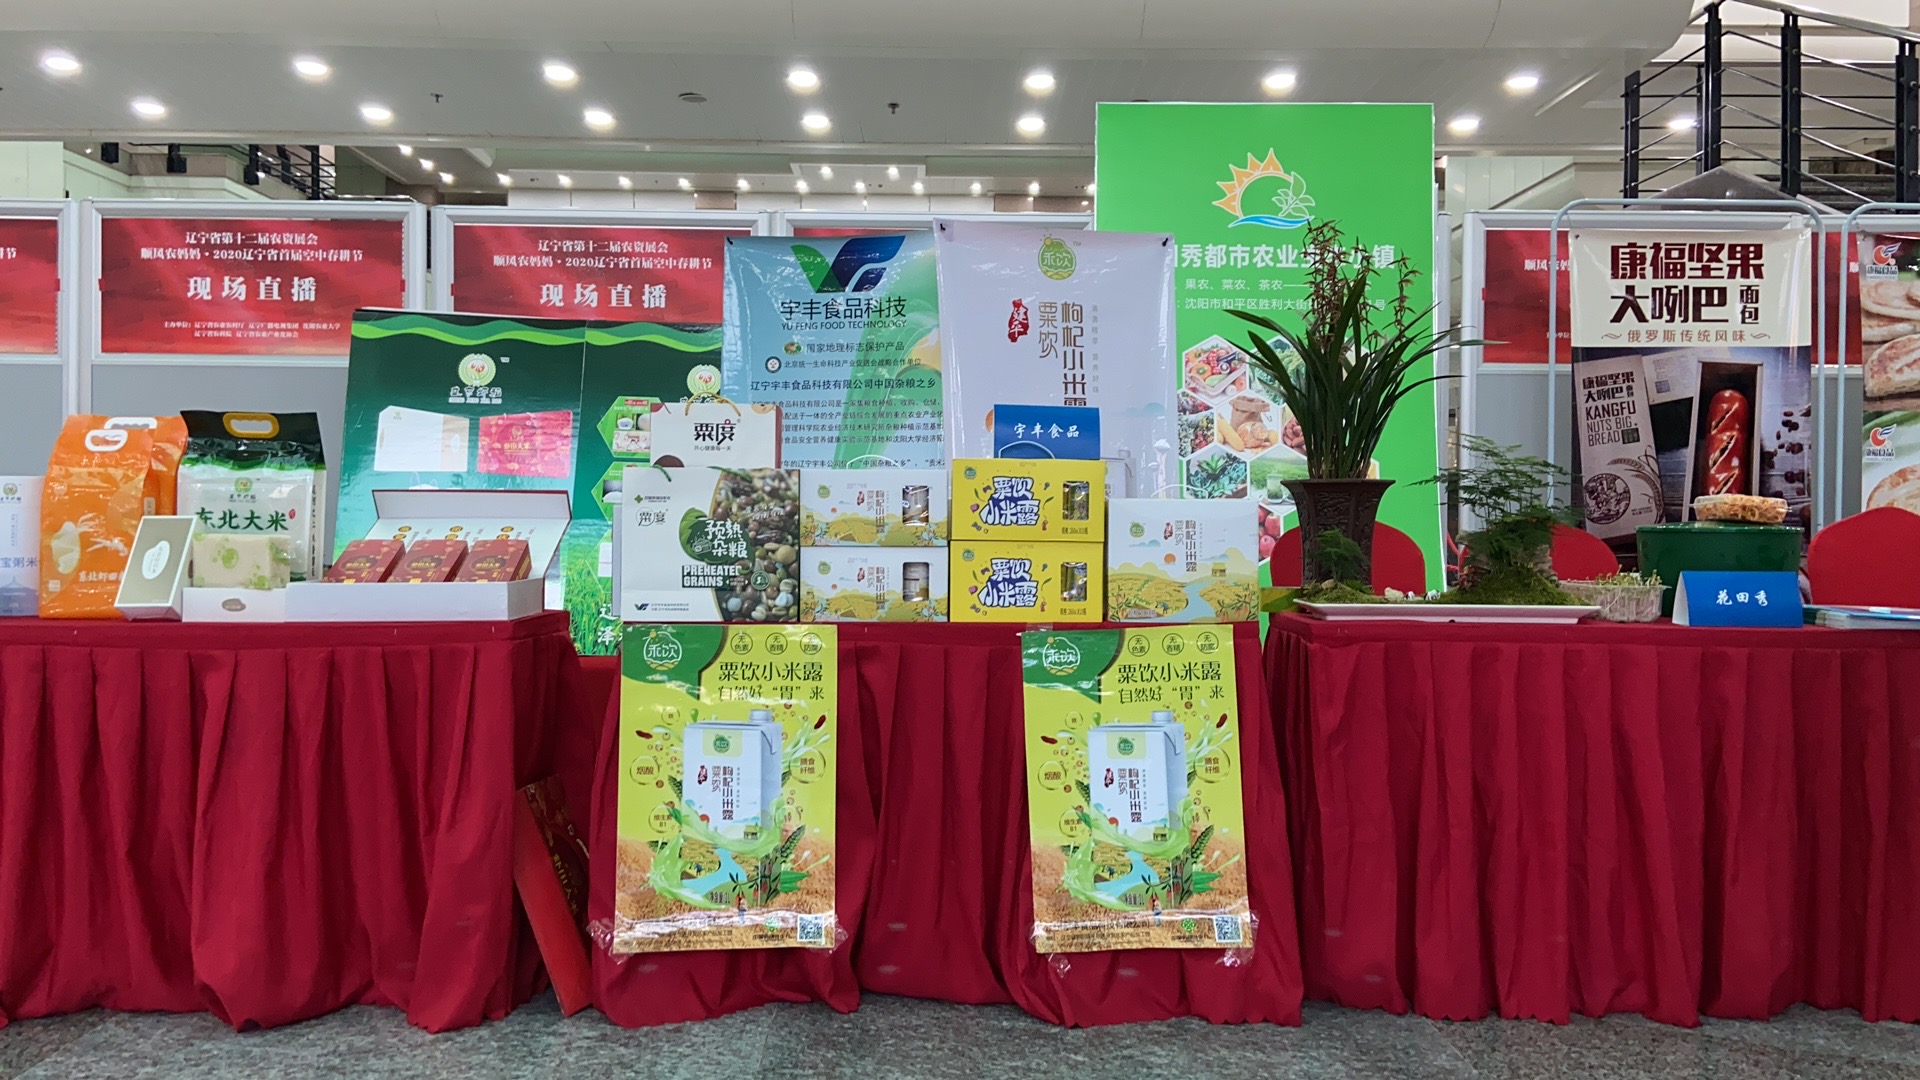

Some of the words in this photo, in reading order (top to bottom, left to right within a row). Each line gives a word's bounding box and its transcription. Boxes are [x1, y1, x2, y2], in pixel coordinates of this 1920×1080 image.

[185, 232, 318, 245] 辽宁省第十二届农资展会
[538, 240, 668, 254] 辽宁省第十二届农资展会
[1610, 242, 1765, 280] 康福坚果
[187, 276, 316, 302] 现场直播
[540, 283, 667, 308] 现场直播
[781, 297, 907, 320] 宇丰食品科技
[1610, 285, 1729, 323] 大咧巴
[1740, 285, 1759, 324] 面包
[782, 322, 793, 330] YU
[796, 321, 818, 330] FENG
[820, 320, 845, 330] FOOD
[848, 319, 907, 329] TECHNOLOGY
[1627, 329, 1746, 343] 俄罗斯传统风味
[806, 341, 905, 352] 国家地理标志保护产品
[751, 378, 936, 391] 辽宁宇丰食品科技有限公司中国杂粮之乡
[1582, 371, 1636, 391] 康福坚果
[1584, 386, 1626, 404] 大咧巴
[1585, 401, 1637, 422] KANGFU
[694, 419, 737, 446] 粟度
[1014, 423, 1080, 439] 宇丰食品
[1587, 418, 1612, 434] NUTS
[1588, 431, 1621, 447] BREAD
[992, 476, 1034, 499] 粟饮
[195, 506, 289, 532] 东北大米
[980, 499, 1040, 525] 小米露
[705, 519, 743, 540] 预熟
[712, 539, 748, 558] 杂粮
[990, 558, 1032, 581] 粟饮
[684, 576, 723, 587] GRAINS
[978, 581, 1039, 607] 小米露
[1715, 589, 1771, 607] 花田秀
[738, 635, 747, 644] 无
[772, 635, 781, 644] 无
[1134, 637, 1143, 646] 无
[1169, 636, 1177, 644] 无
[1203, 634, 1212, 643] 无
[718, 661, 823, 682] 粟饮小米露
[1118, 661, 1222, 684] 粟饮小米露
